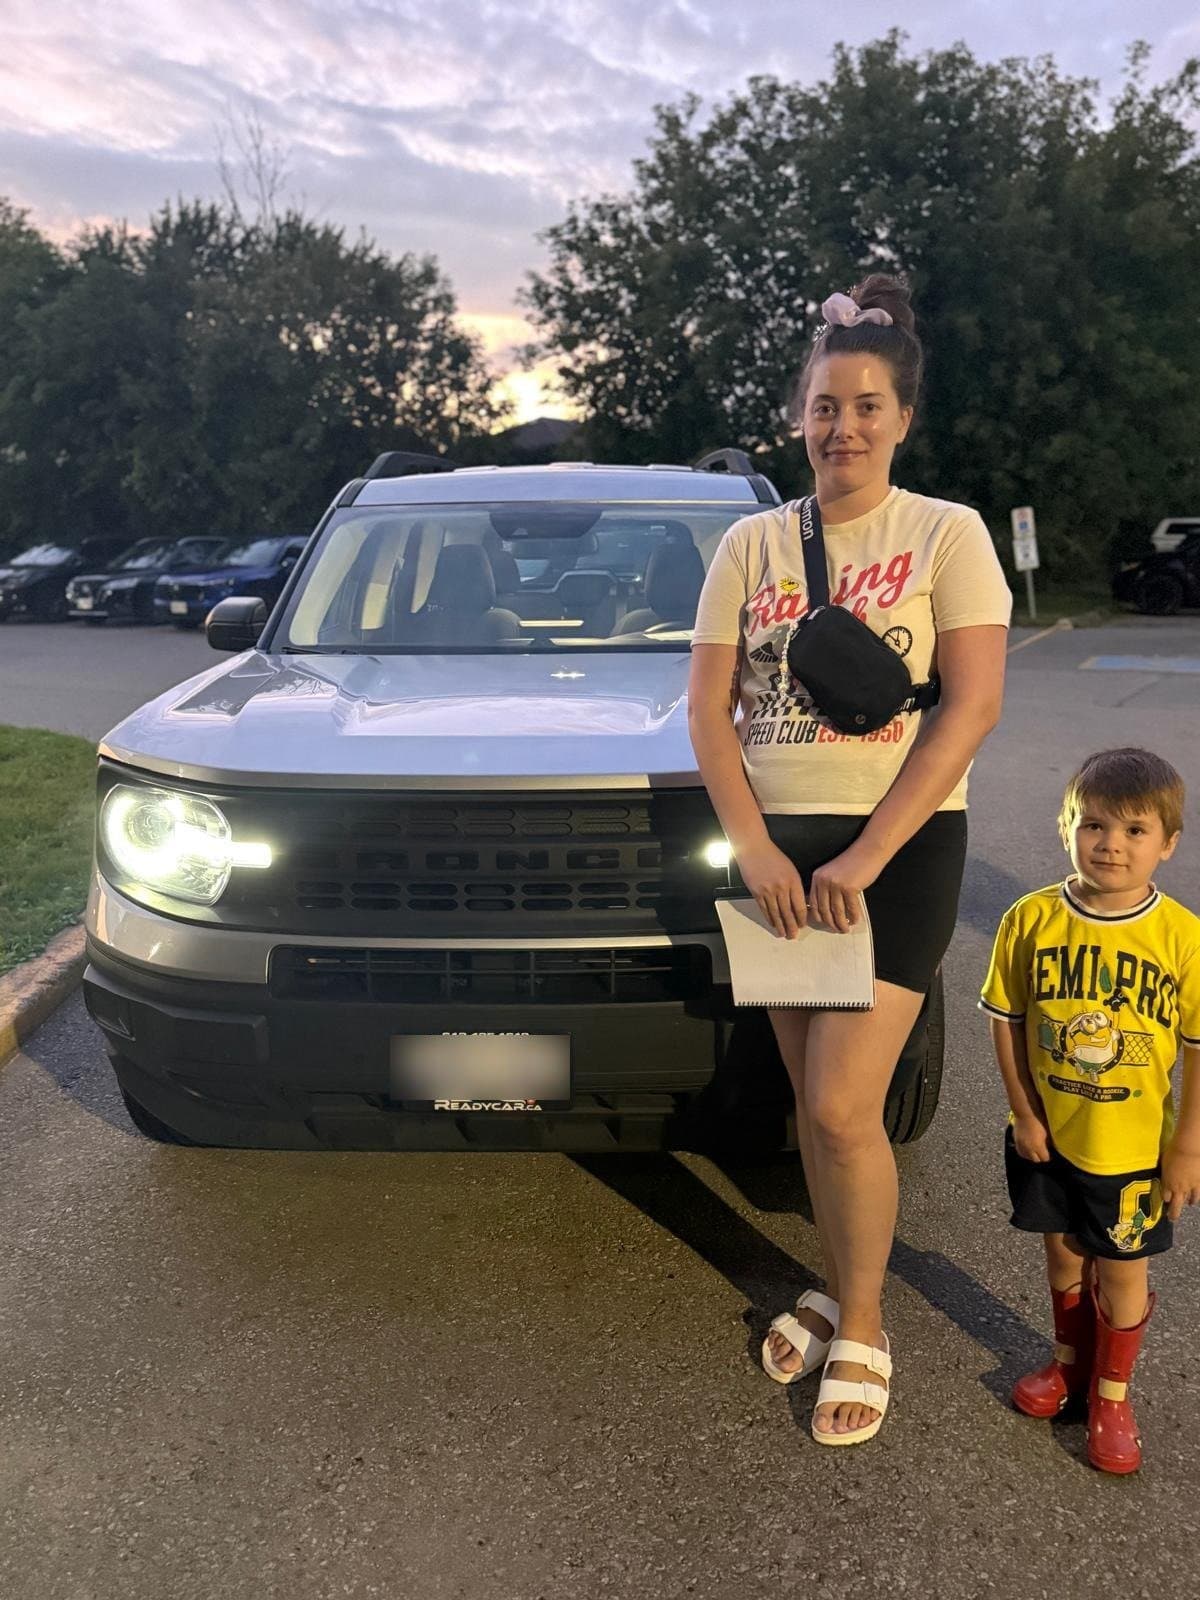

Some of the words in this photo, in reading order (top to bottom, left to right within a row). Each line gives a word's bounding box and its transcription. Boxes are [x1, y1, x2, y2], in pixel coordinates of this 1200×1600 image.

[801, 500, 814, 541] emon
[749, 551, 913, 637] Raing
[744, 721, 776, 746] SPEED
[776, 720, 820, 745] CLUB
[1035, 944, 1101, 1001] EMI
[1116, 950, 1176, 1029] PRO
